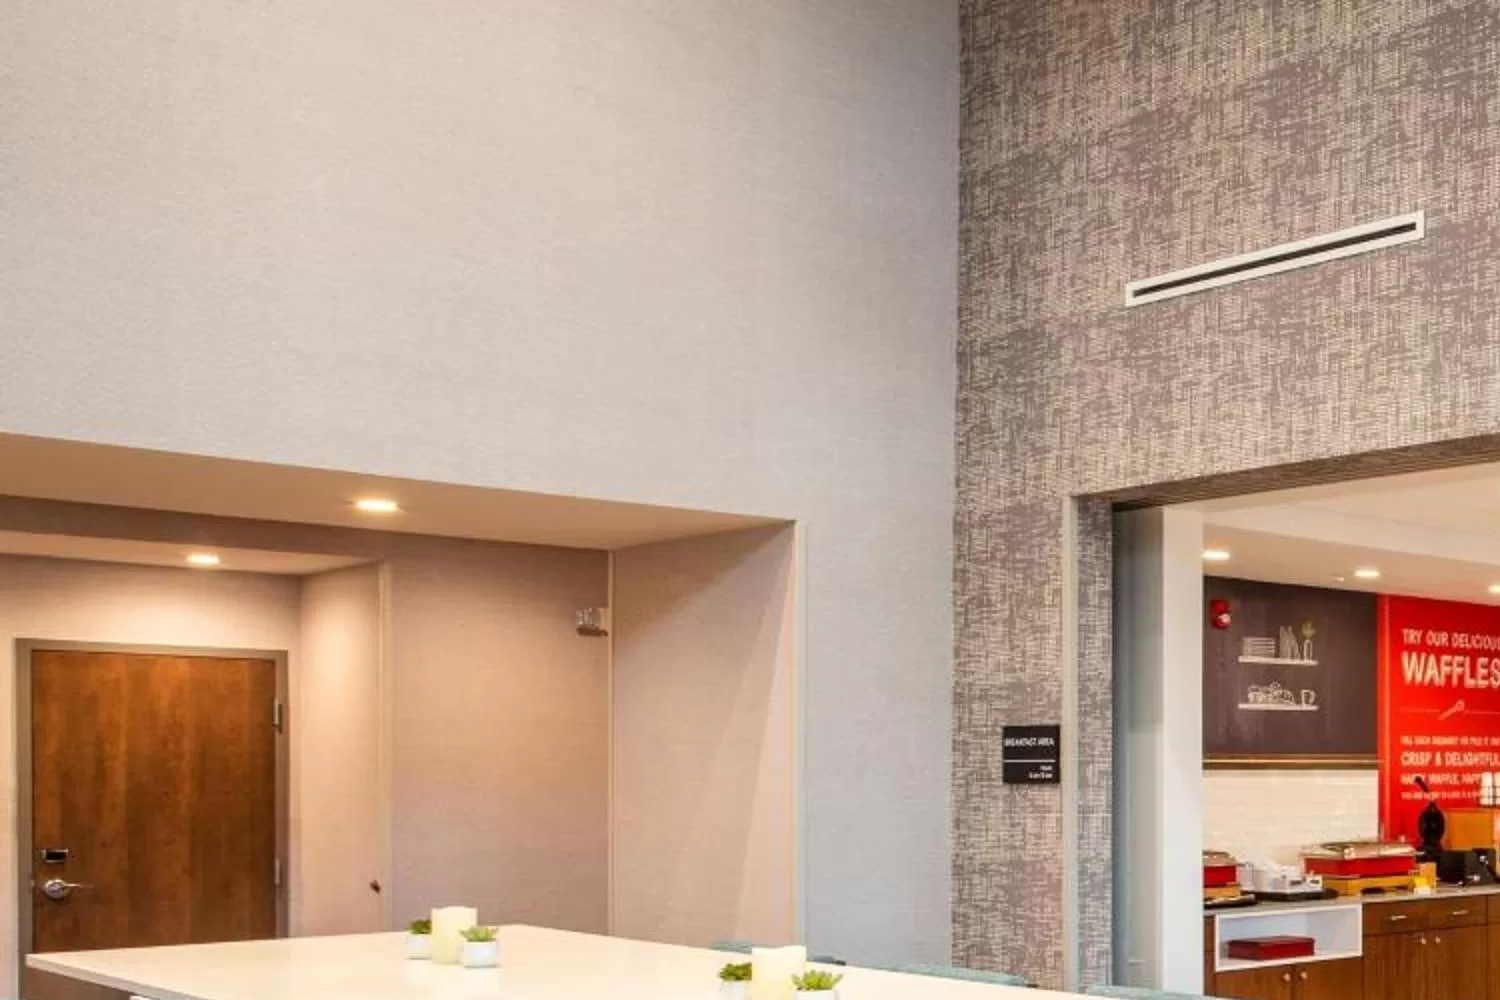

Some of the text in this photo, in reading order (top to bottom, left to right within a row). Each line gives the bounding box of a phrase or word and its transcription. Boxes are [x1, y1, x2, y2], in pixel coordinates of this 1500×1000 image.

[1402, 628, 1422, 644] TRY
[1426, 630, 1449, 647] OUR
[1401, 752, 1432, 767] CRISP
